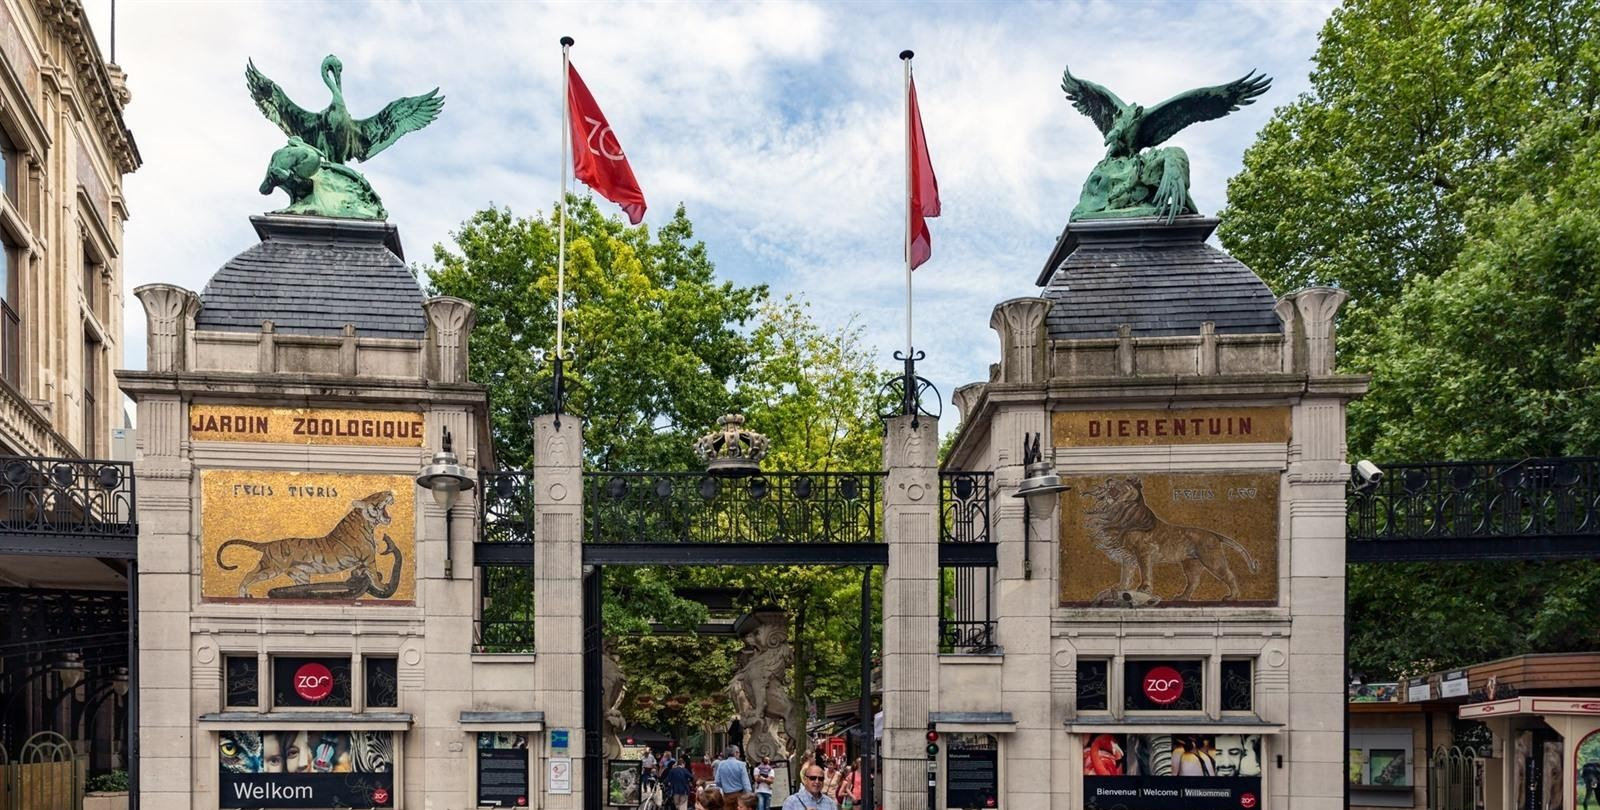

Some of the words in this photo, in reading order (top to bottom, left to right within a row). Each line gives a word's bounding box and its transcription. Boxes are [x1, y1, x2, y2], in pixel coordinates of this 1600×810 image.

[191, 414, 268, 434] JARDIN
[293, 417, 423, 439] ZOOLOGIQUE
[1088, 417, 1252, 438] DIERENTUIN
[233, 782, 313, 799] Welkom
[1096, 787, 1137, 797] Bienvenue
[1143, 788, 1179, 797] Welcome
[1184, 787, 1230, 798] Willkommen
